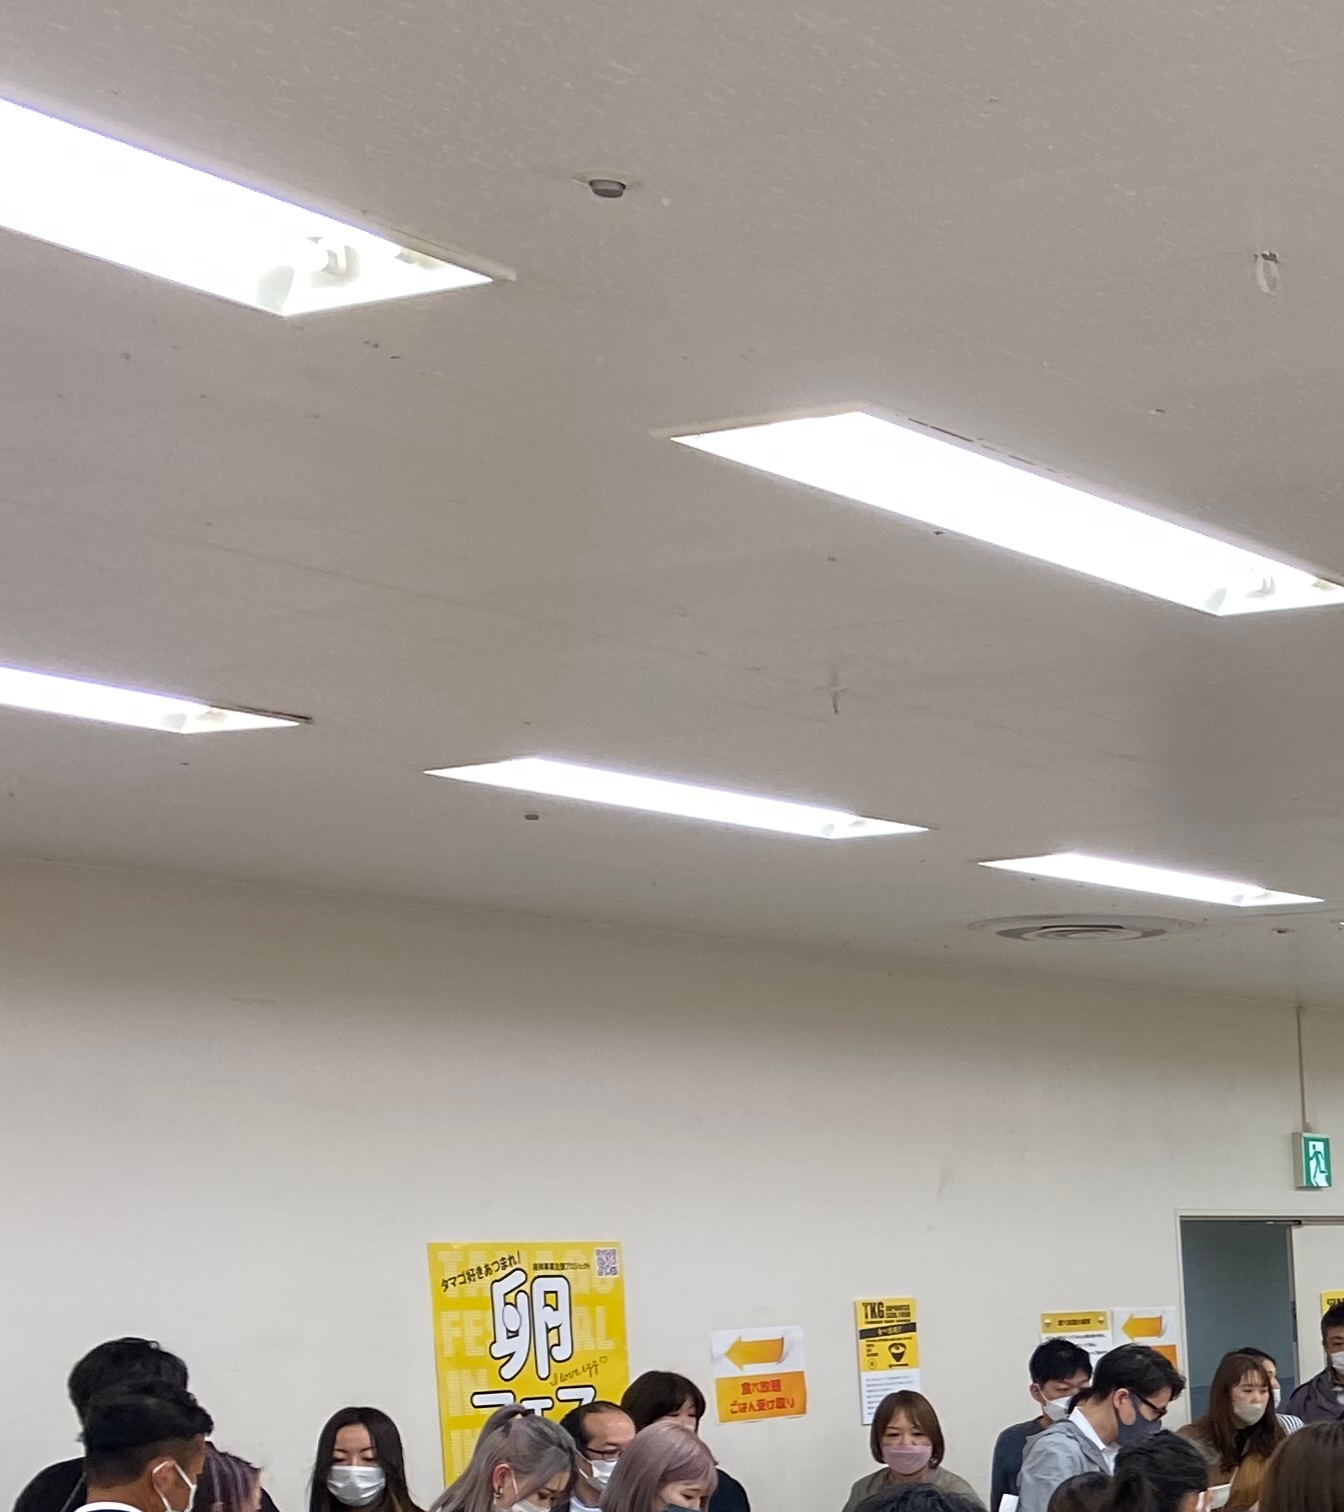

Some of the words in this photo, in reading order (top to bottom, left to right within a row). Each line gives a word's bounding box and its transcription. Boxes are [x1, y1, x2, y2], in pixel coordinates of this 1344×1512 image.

[862, 1301, 885, 1320] TKG
[489, 1268, 574, 1381] 卵
[741, 1379, 782, 1396] 食べ放題
[730, 1397, 795, 1415] ごはん受け取り
